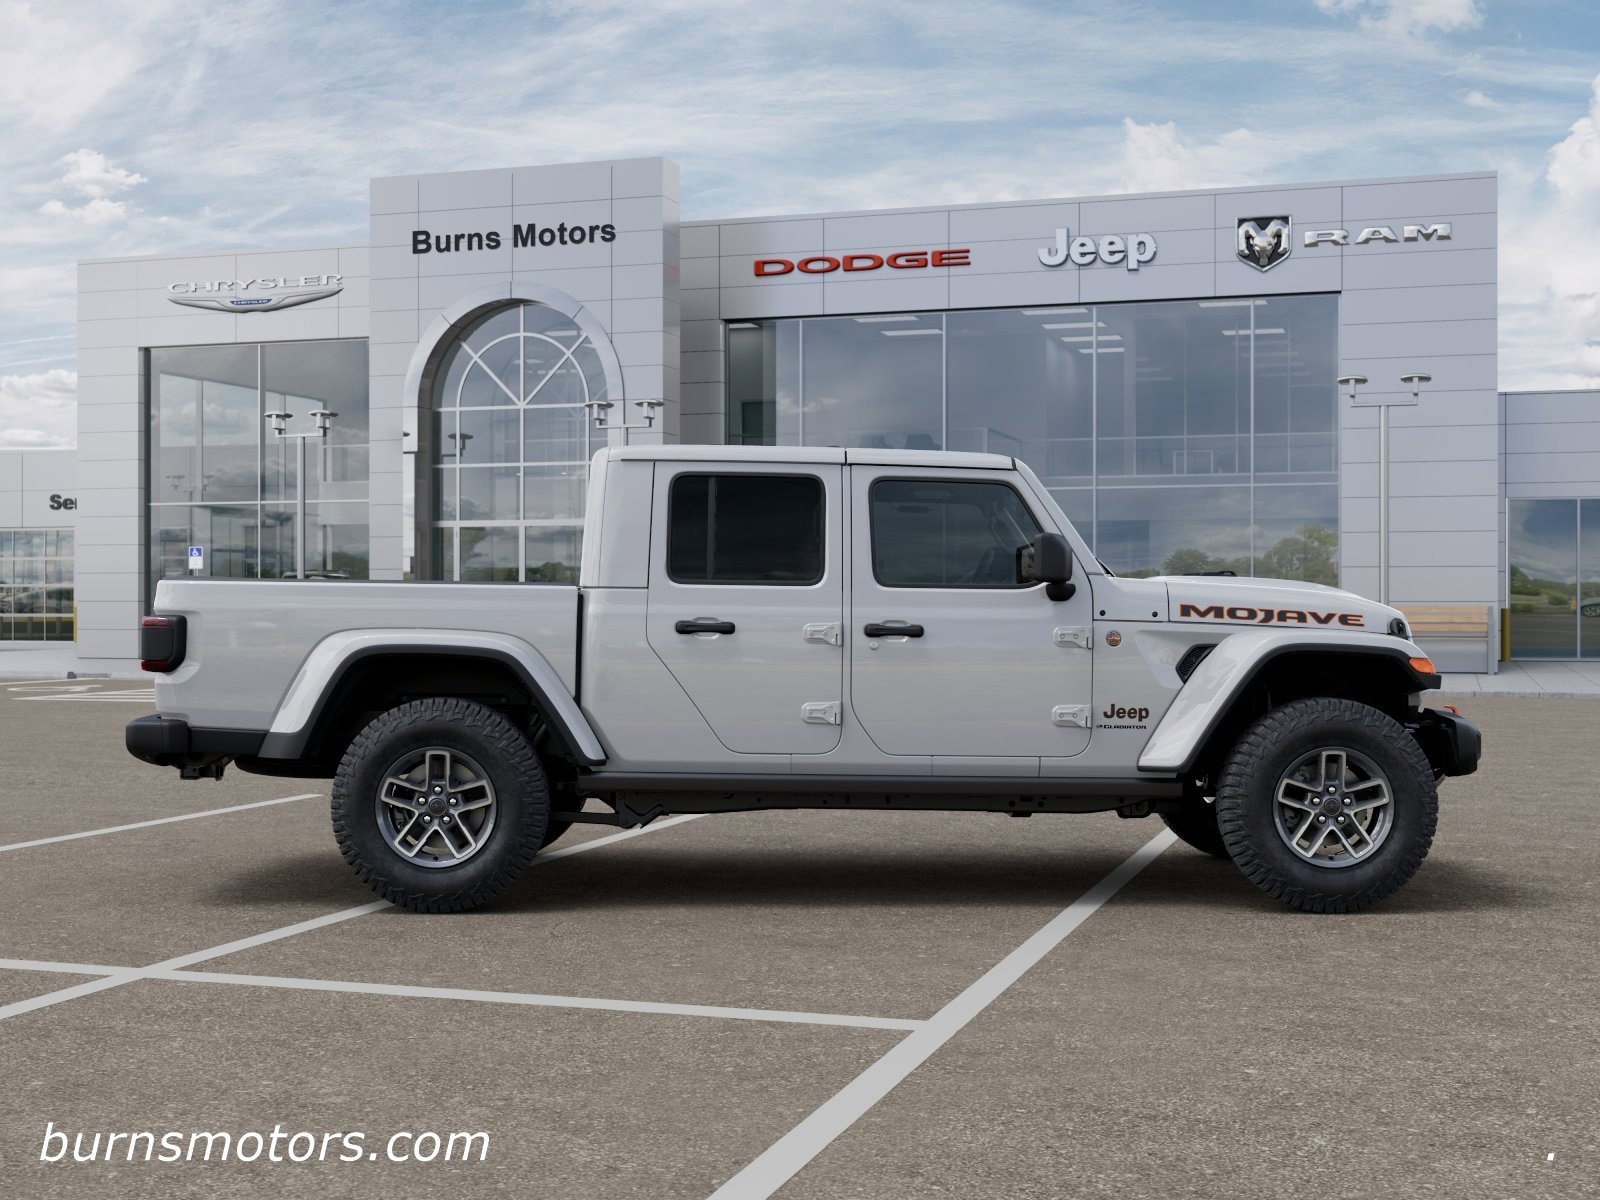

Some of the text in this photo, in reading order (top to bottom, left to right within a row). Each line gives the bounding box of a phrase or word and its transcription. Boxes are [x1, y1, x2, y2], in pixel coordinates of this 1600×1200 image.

[412, 222, 616, 254] Burns Motors
[1304, 222, 1453, 248] RAM
[753, 248, 971, 277] DODGE
[1037, 227, 1157, 272] Jeep
[167, 273, 343, 294] CHRYSLER
[1179, 603, 1365, 628] MOJAVE
[1103, 703, 1150, 722] Jeep
